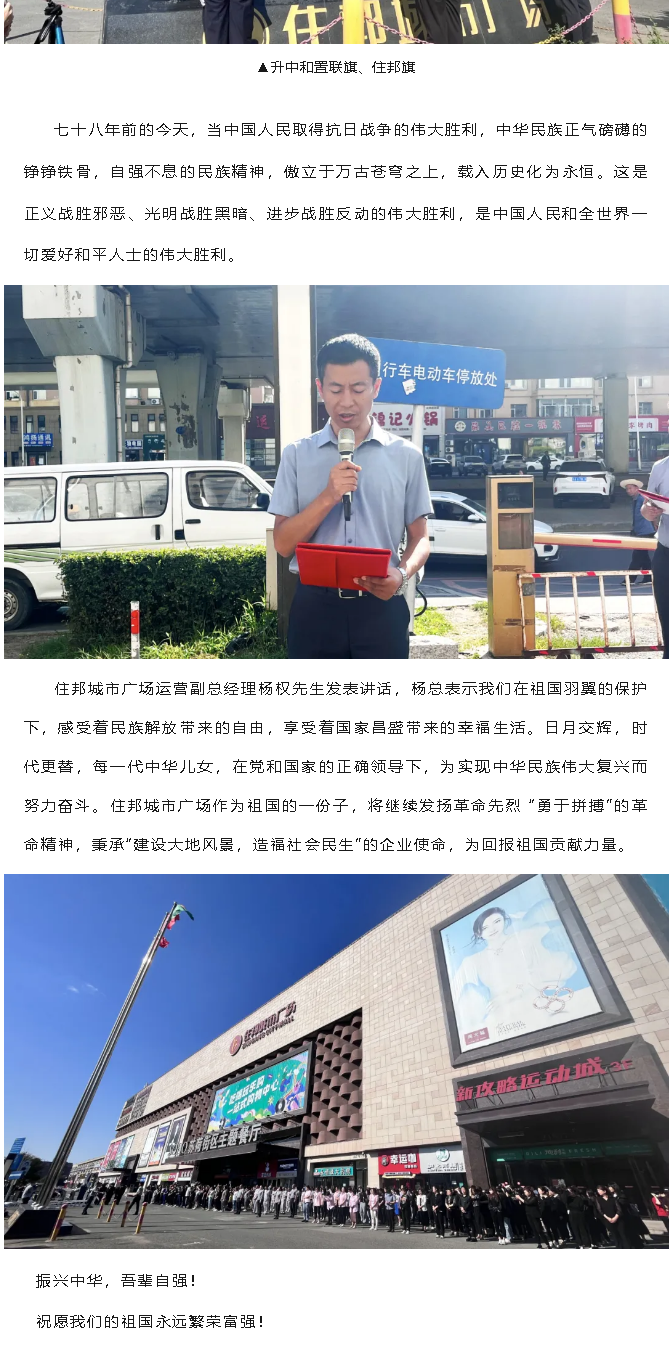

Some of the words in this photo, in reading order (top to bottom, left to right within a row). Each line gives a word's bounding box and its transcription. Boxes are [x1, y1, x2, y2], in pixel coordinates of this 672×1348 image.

[378, 361, 498, 387] 行车电动车停放处
[456, 1057, 607, 1102] 新攻略运动城
[610, 1059, 634, 1073] 3F
[188, 1123, 262, 1154] 苏荷街区主题餐厅
[390, 1153, 418, 1165] 幸运咖
